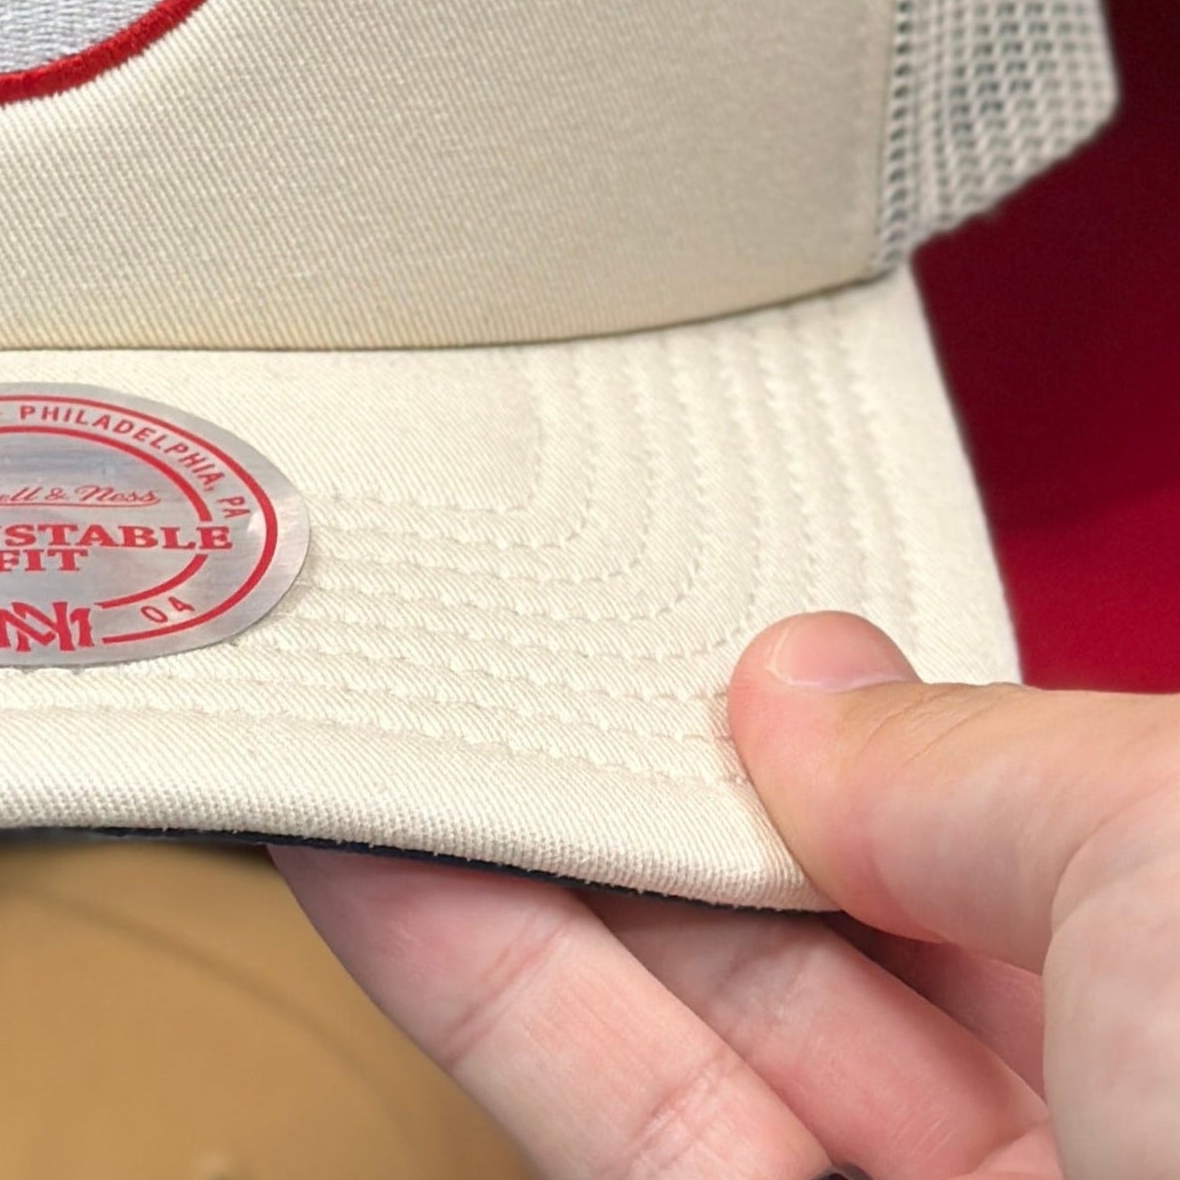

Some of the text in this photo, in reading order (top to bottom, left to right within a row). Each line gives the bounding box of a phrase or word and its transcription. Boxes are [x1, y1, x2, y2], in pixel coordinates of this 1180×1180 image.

[20, 404, 222, 493] PHILADELPHIA,
[217, 494, 252, 521] PA
[44, 486, 66, 502] &
[75, 484, 161, 508] Ness
[140, 594, 196, 624] 04
